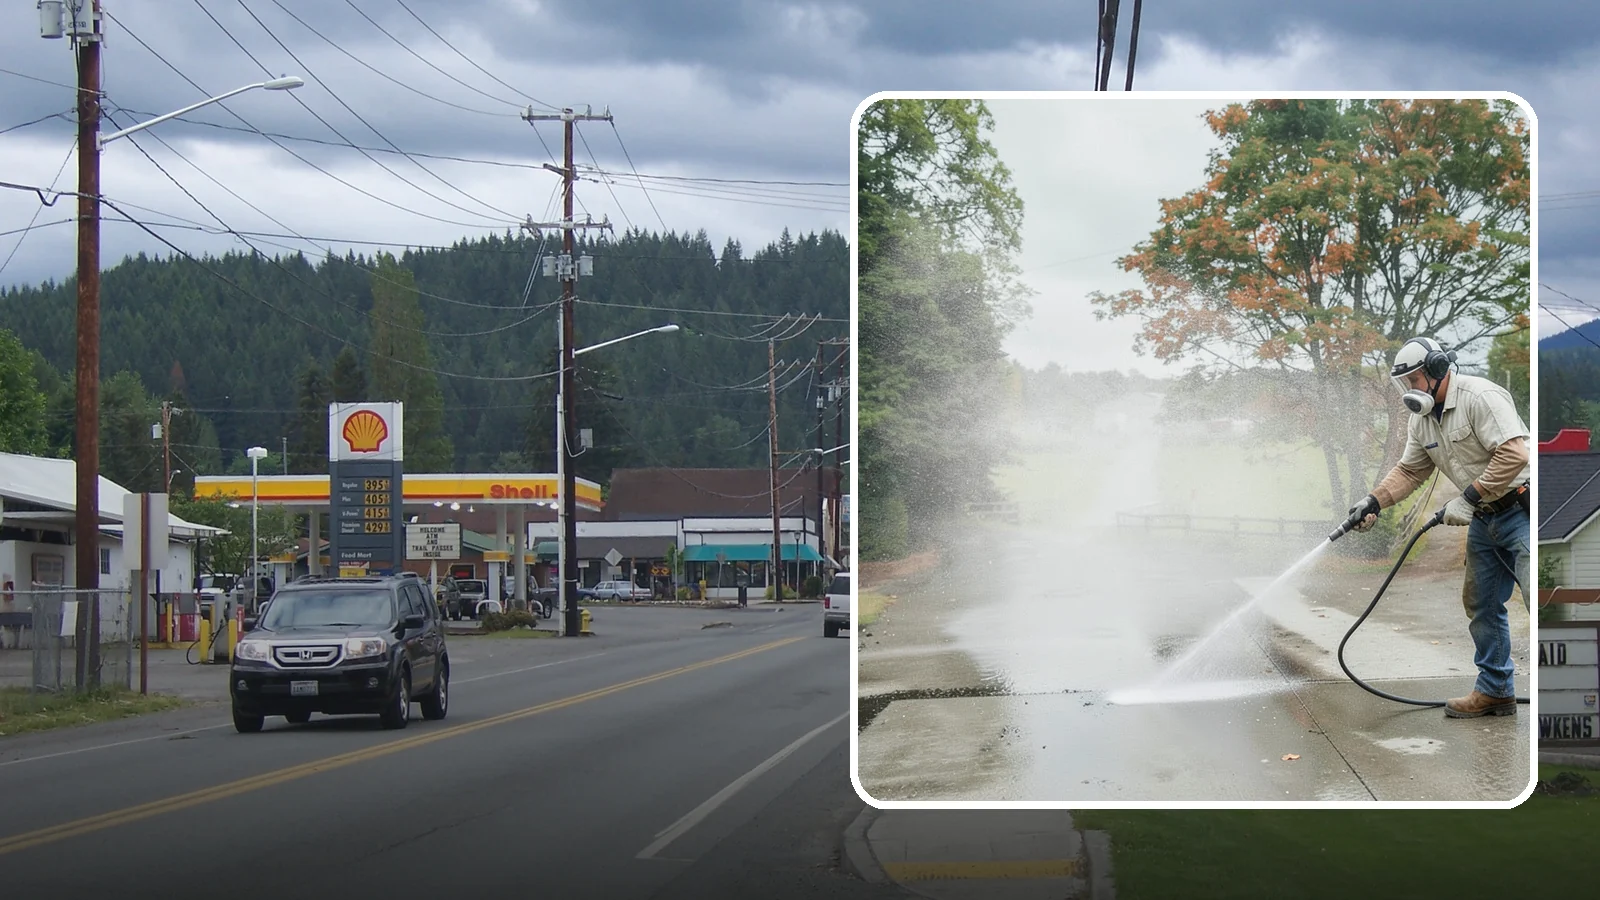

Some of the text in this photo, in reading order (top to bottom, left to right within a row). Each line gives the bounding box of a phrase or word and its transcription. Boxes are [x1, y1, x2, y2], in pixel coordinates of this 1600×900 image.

[366, 480, 384, 490] 395
[490, 484, 547, 499] Shell
[366, 494, 384, 504] 405
[366, 508, 384, 518] 415
[366, 522, 384, 533] 429
